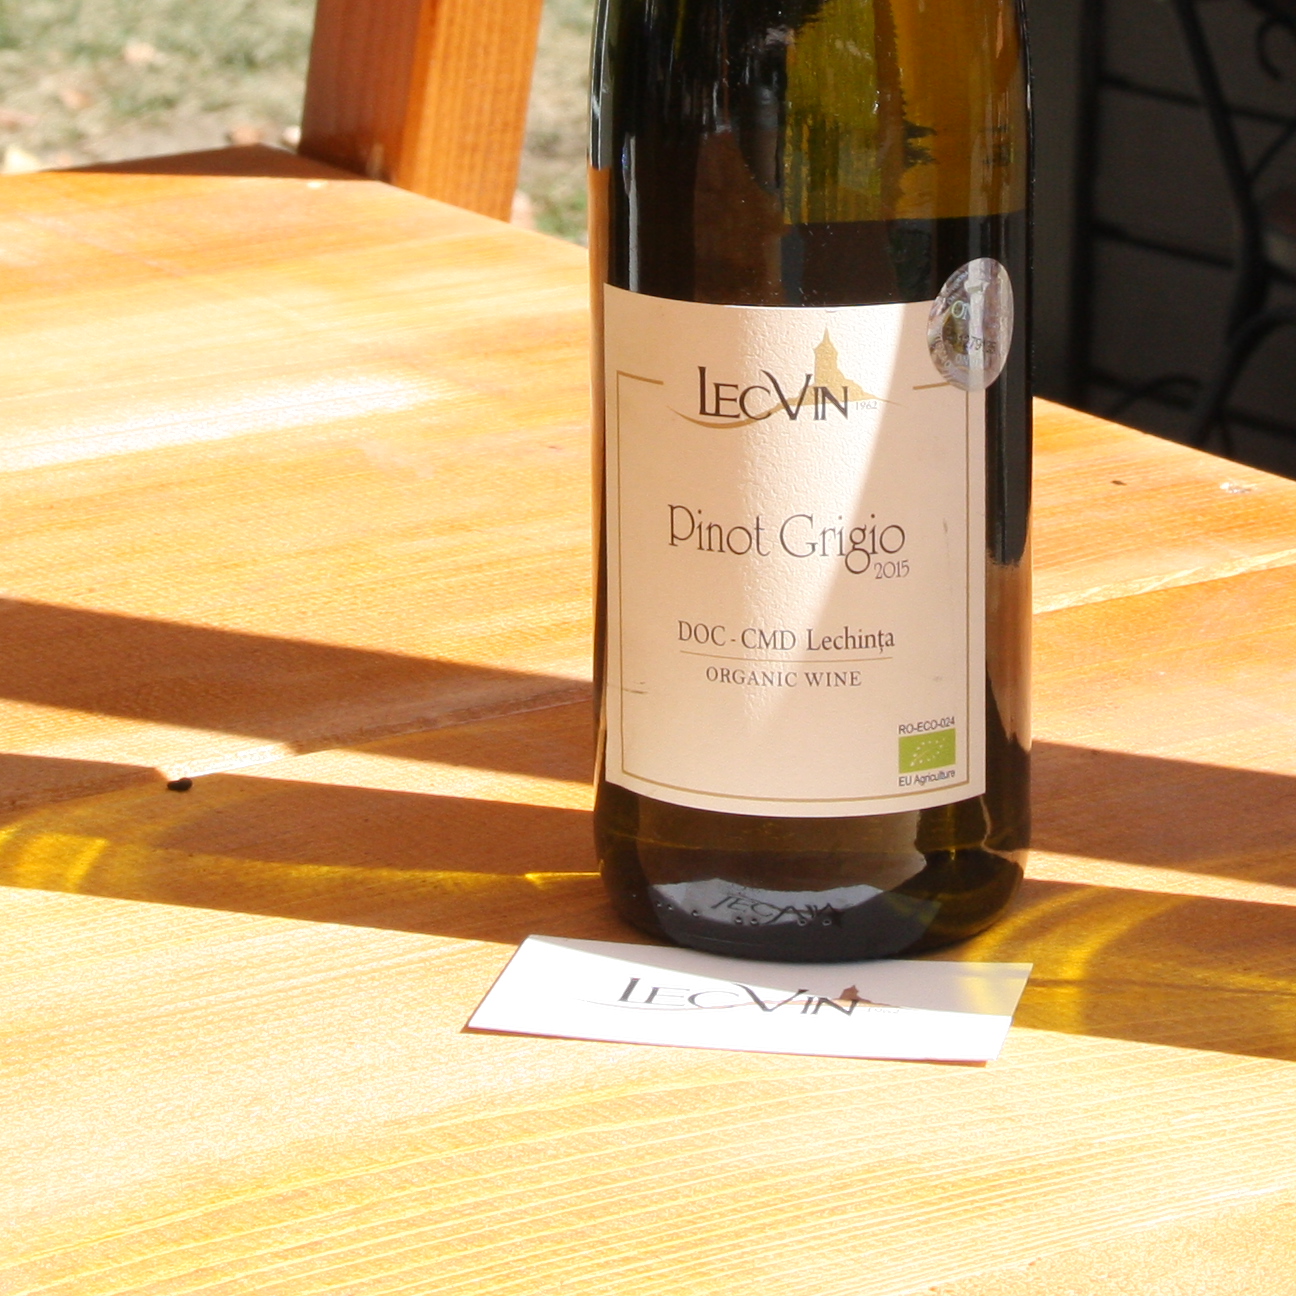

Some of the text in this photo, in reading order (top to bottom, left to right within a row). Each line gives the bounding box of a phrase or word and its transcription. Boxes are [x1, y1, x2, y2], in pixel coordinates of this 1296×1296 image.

[668, 504, 906, 574] Pinot Grigio
[873, 559, 910, 580] 2015
[706, 666, 862, 688] ORGANIC WINE
[898, 716, 956, 735] RO-ECO-024
[898, 768, 956, 787] EU Agriculture
